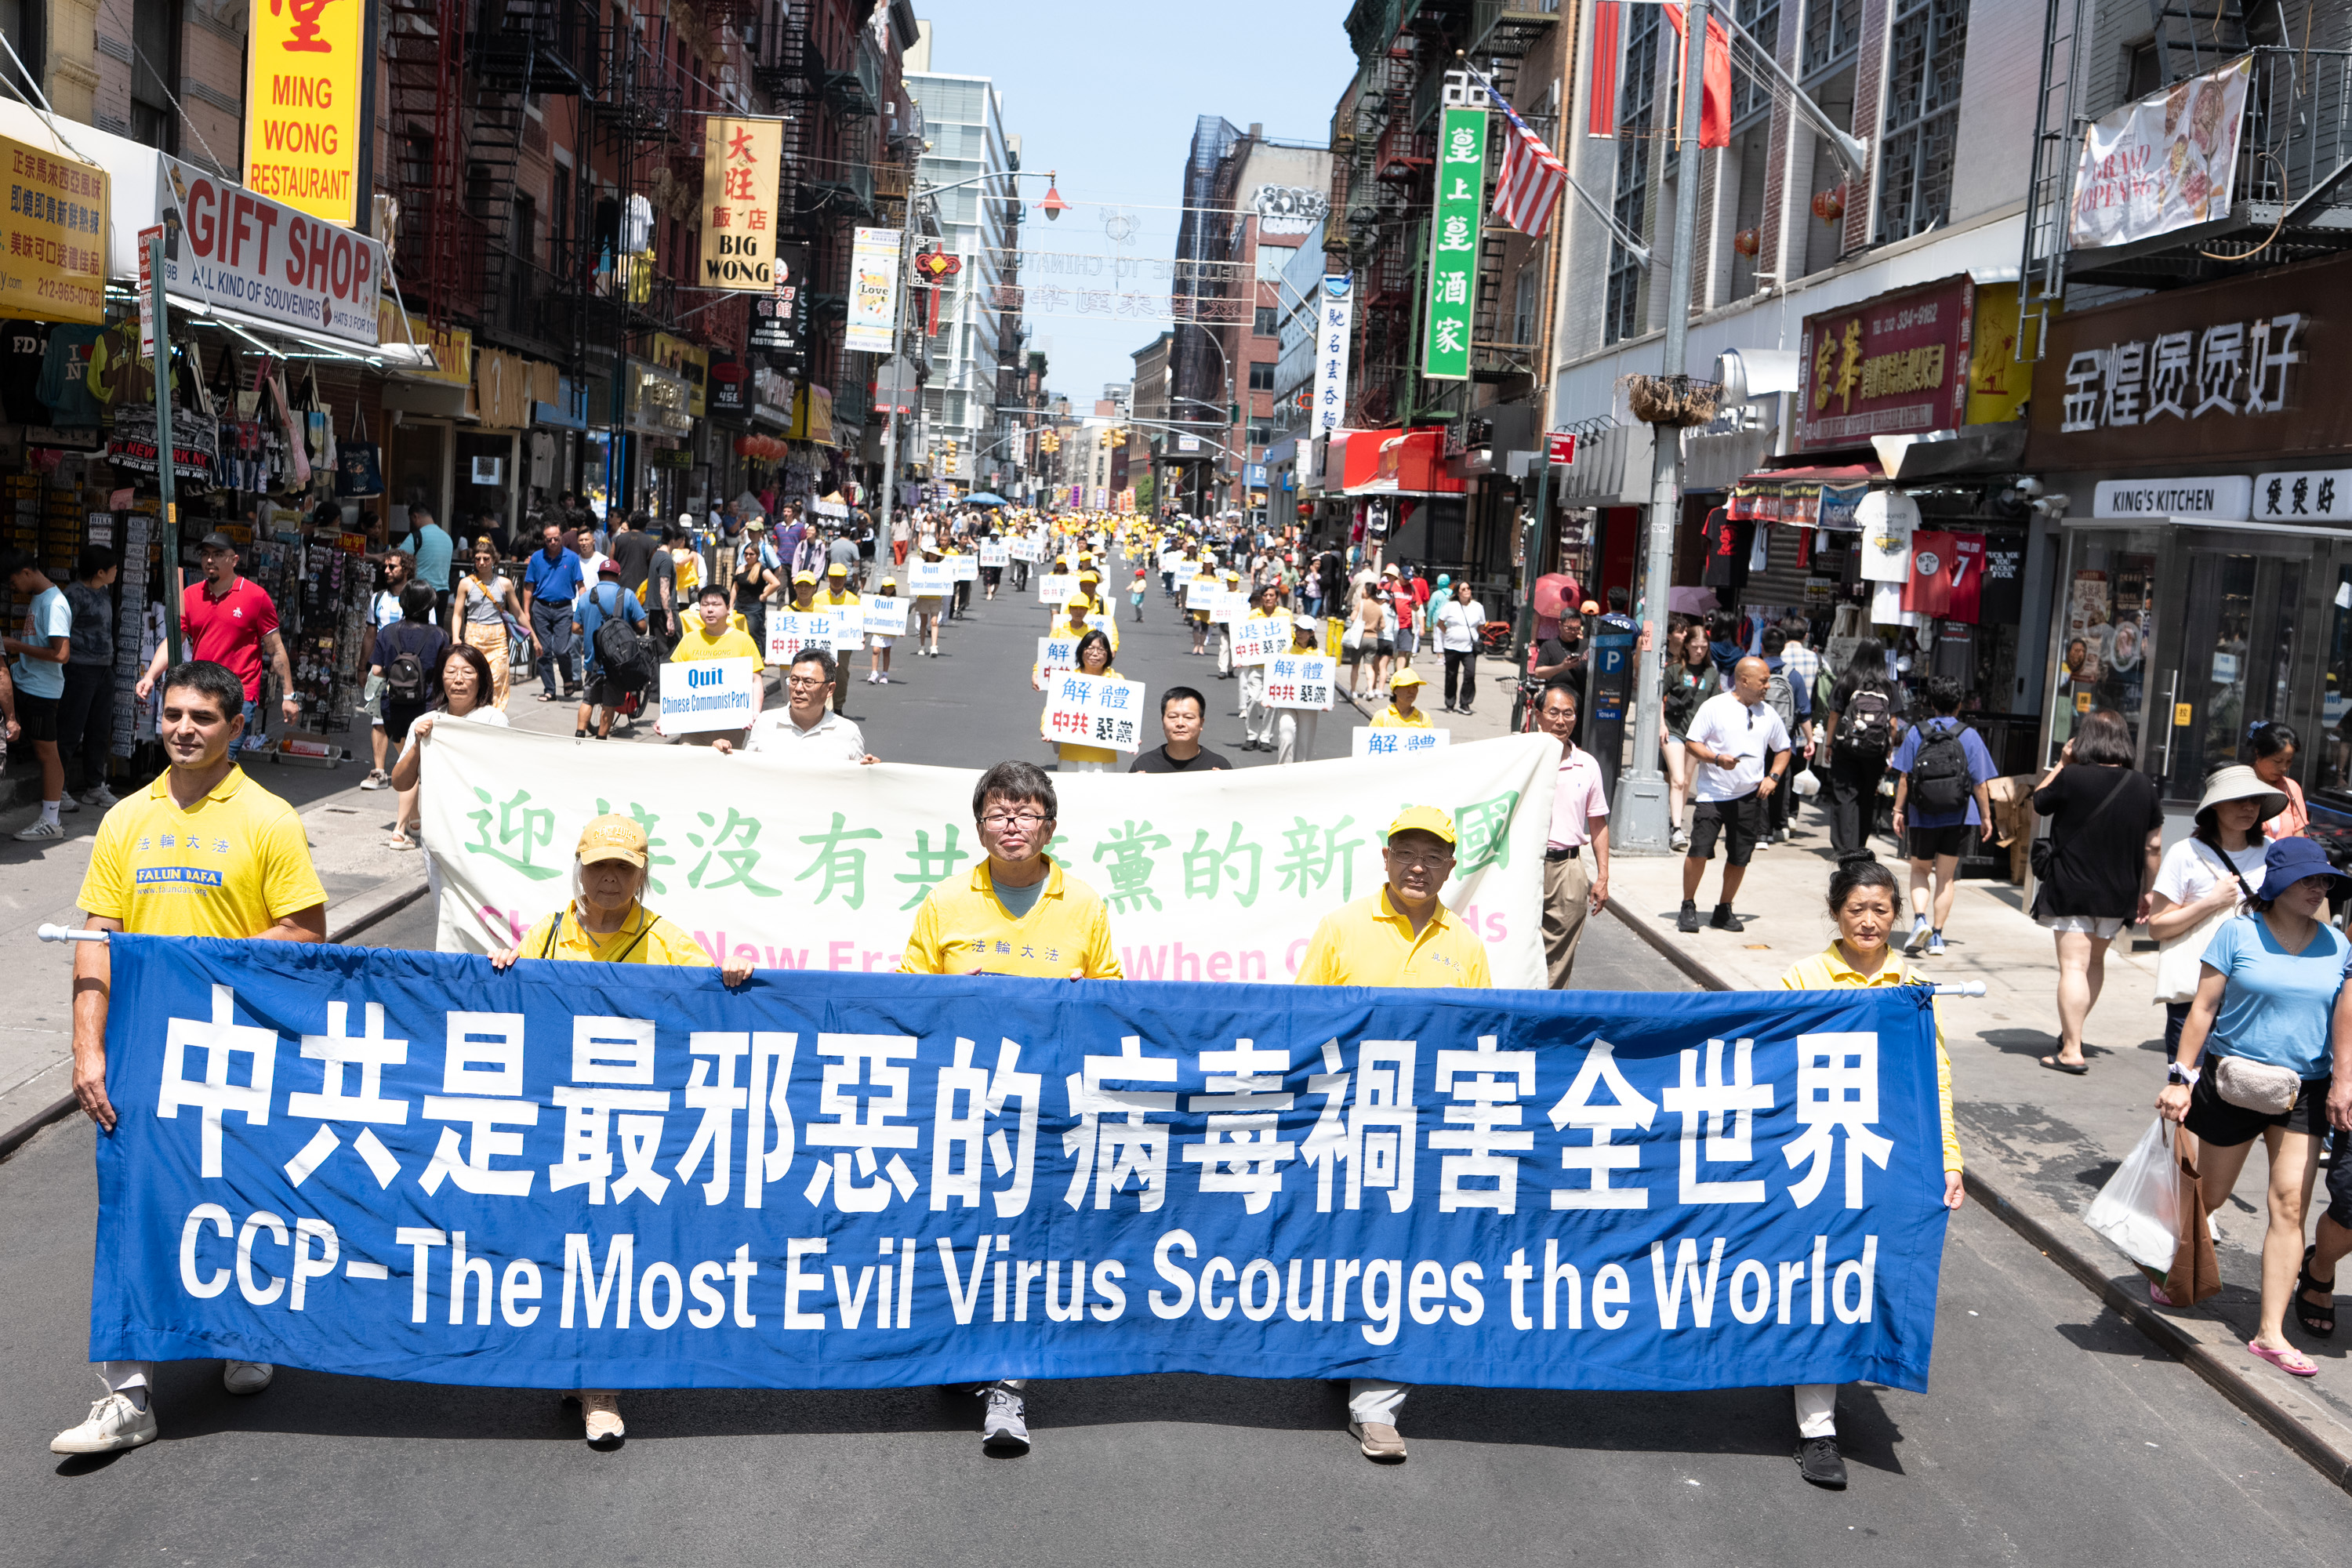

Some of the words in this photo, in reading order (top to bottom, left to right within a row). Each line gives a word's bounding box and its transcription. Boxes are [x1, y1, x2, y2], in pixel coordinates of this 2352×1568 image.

[272, 74, 332, 109] MING
[263, 119, 339, 156] WONG
[726, 125, 758, 201] 大旺
[2092, 143, 2151, 182] GRAND
[13, 149, 101, 200] 正宗馬來西亞風味
[251, 163, 350, 202] RESTAURANT
[2082, 170, 2152, 213] OPENING
[713, 206, 768, 230] 飯店
[10, 230, 100, 275] 美味可口送禮佳品
[139, 235, 144, 248] NO
[187, 179, 278, 276] GIFT
[286, 216, 371, 304] SHOP
[719, 235, 757, 257] BIG
[706, 260, 770, 283] WONG
[37, 277, 100, 308] 212-965-0796
[192, 265, 214, 291] ALL
[218, 270, 244, 298] KIND
[248, 283, 262, 303] OF
[264, 285, 320, 321] SOUVENIRS
[861, 285, 889, 296] Love
[333, 310, 348, 326] HATS
[348, 316, 353, 328] 3
[354, 318, 366, 331] FOR
[366, 321, 376, 336] $10
[764, 321, 781, 329] NEW
[1897, 303, 1938, 330] 334-9162
[750, 337, 795, 347] RESTAURANT
[1321, 307, 1346, 428] 馳名雲吞麵
[2061, 312, 2305, 433] 金煌煲煲好
[126, 441, 157, 459] NEW
[2113, 488, 2154, 512] KING'S
[2157, 488, 2215, 511] KITCHEN
[2266, 476, 2335, 515] 煲煲好
[343, 535, 352, 546] for
[2005, 551, 2021, 560] YOU
[922, 565, 938, 575] Quit
[1951, 555, 1970, 587] 7
[874, 599, 894, 610] Quit
[775, 616, 830, 634] 退出
[850, 628, 862, 638] Party
[897, 619, 906, 629] Party
[1239, 621, 1282, 640] 退出
[1047, 642, 1070, 662] 解
[1606, 650, 1621, 671] P
[688, 667, 724, 688] Quit
[1273, 659, 1324, 681] 解體
[662, 695, 691, 714] Chinese
[691, 691, 731, 712] Communist
[731, 691, 750, 710] Party
[1062, 677, 1130, 710] 解體
[1269, 684, 1327, 703] 中共惡黨
[2178, 707, 2188, 718] 拉
[1052, 710, 1134, 743] 中共惡黨
[1367, 732, 1436, 756] 解體
[137, 833, 230, 854] 法輪大法
[594, 826, 612, 840] NEW
[615, 826, 637, 844] YORK
[139, 869, 181, 881] FALUN
[186, 869, 218, 884] DAFA
[971, 938, 1059, 963] 法輪大法
[1123, 941, 1267, 983] When
[559, 1232, 757, 1330] Most
[784, 1236, 915, 1330] Evil
[938, 1233, 1126, 1327] Virus
[1147, 1229, 1485, 1348] Scourges
[1505, 1237, 1631, 1332] the
[1650, 1233, 1878, 1332] World
